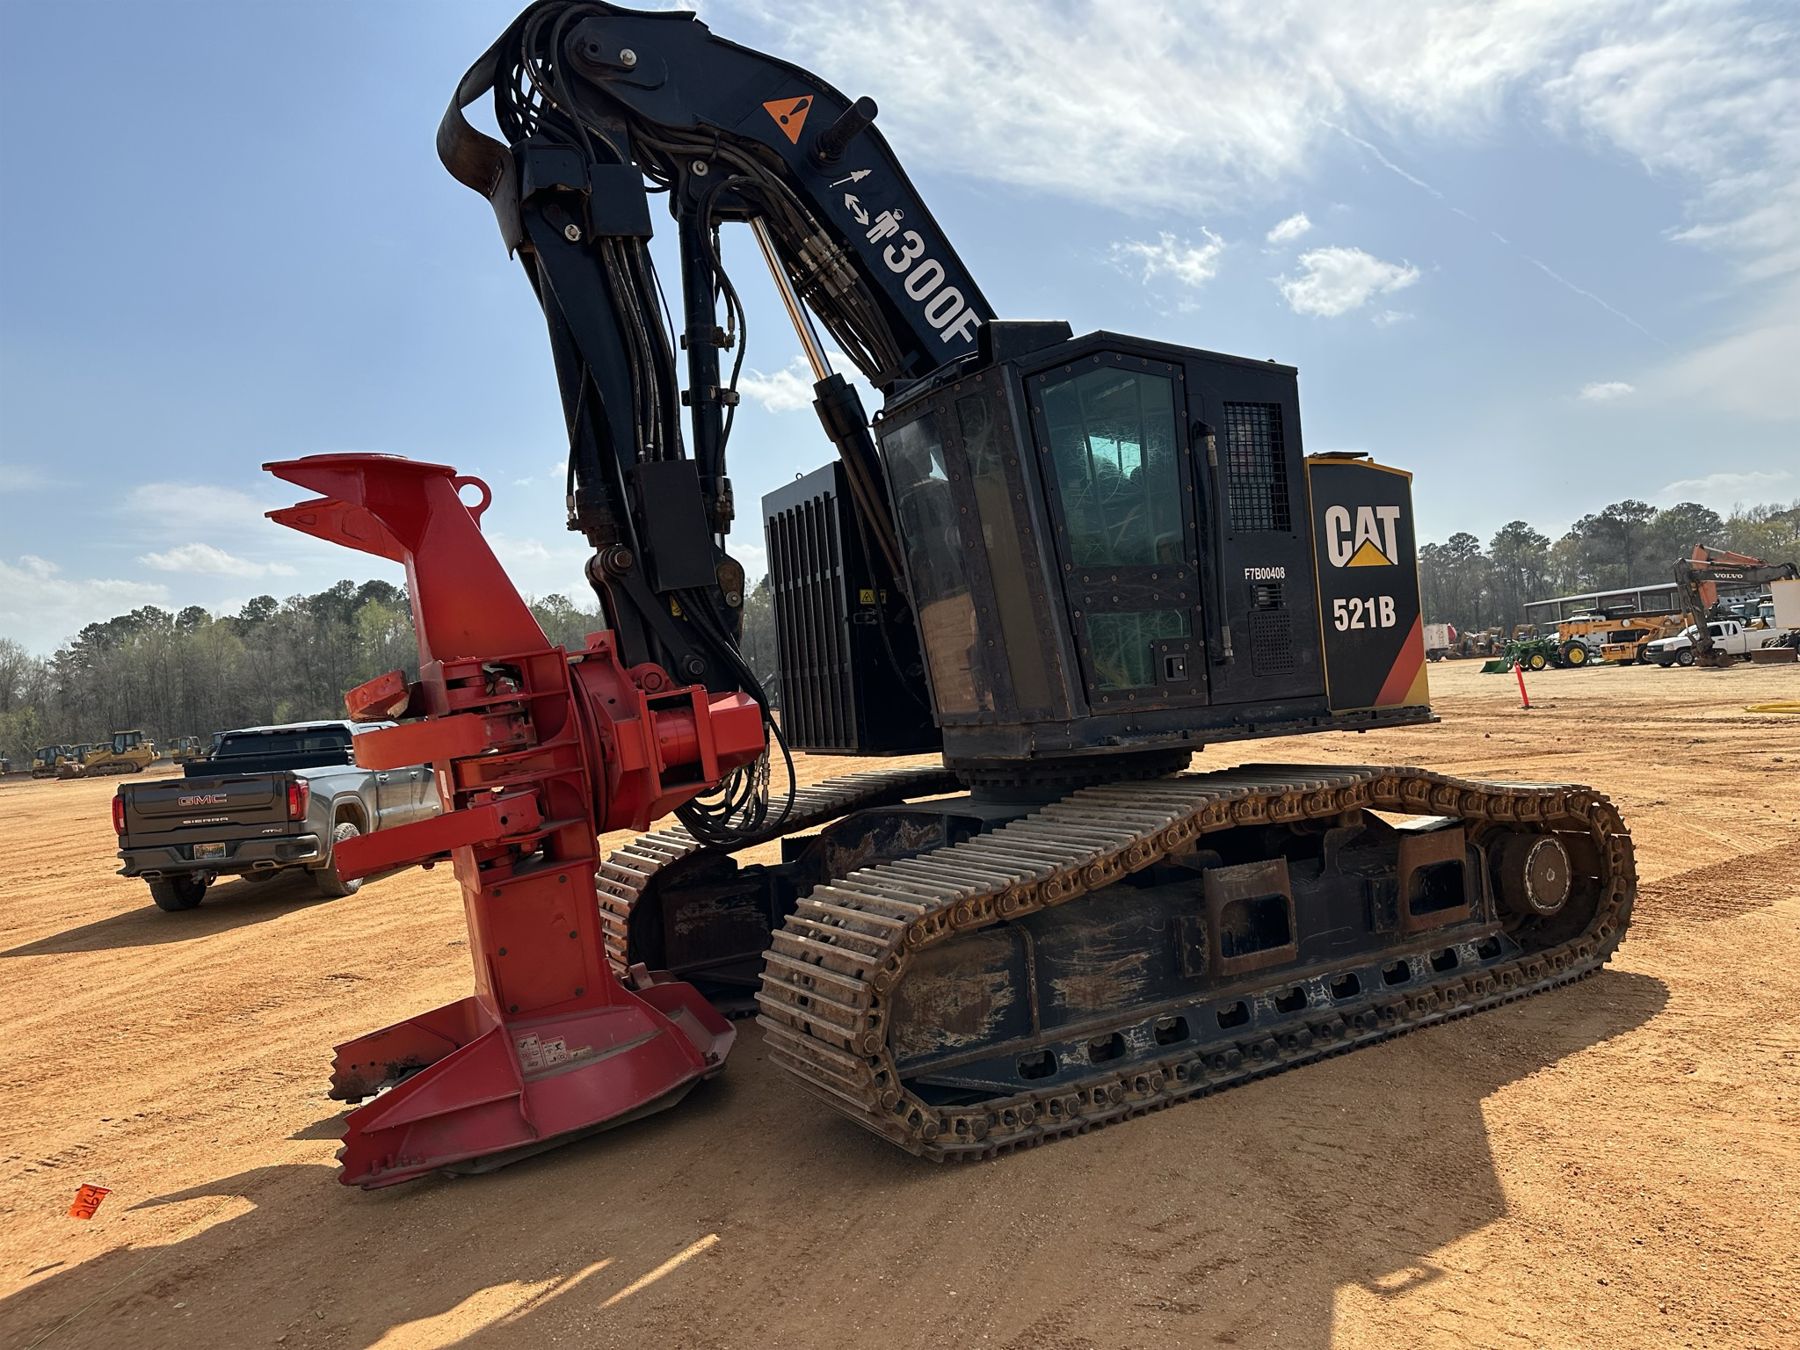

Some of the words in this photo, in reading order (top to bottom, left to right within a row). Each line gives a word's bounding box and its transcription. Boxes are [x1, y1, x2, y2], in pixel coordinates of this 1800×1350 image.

[883, 230, 983, 344] 300F
[1325, 505, 1400, 568] CAT
[1244, 566, 1286, 580] F7B00408
[1333, 595, 1396, 632] 521B
[178, 793, 228, 807] GMC
